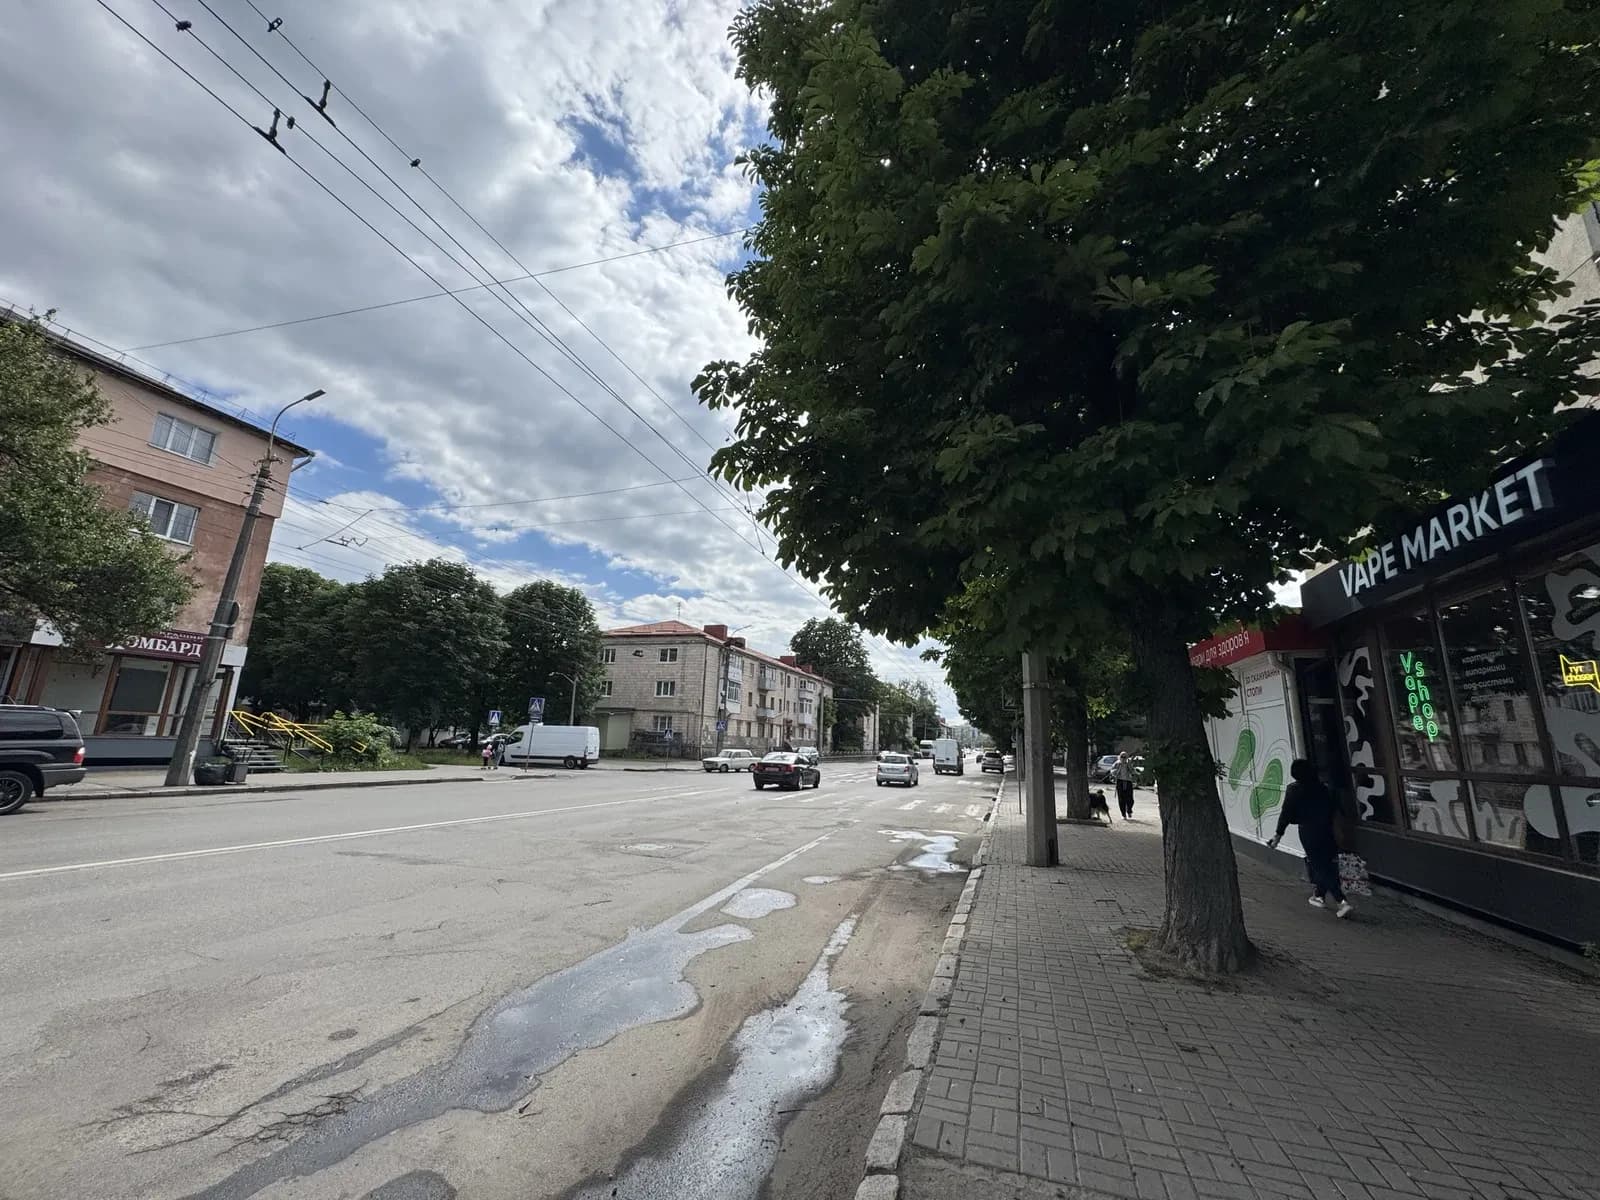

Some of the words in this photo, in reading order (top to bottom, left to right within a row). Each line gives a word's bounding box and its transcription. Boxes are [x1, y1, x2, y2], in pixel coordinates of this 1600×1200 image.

[1338, 541, 1398, 598] VAPE
[1400, 458, 1544, 571] MARKET
[1399, 650, 1424, 731] Vape
[1414, 660, 1439, 743] shop
